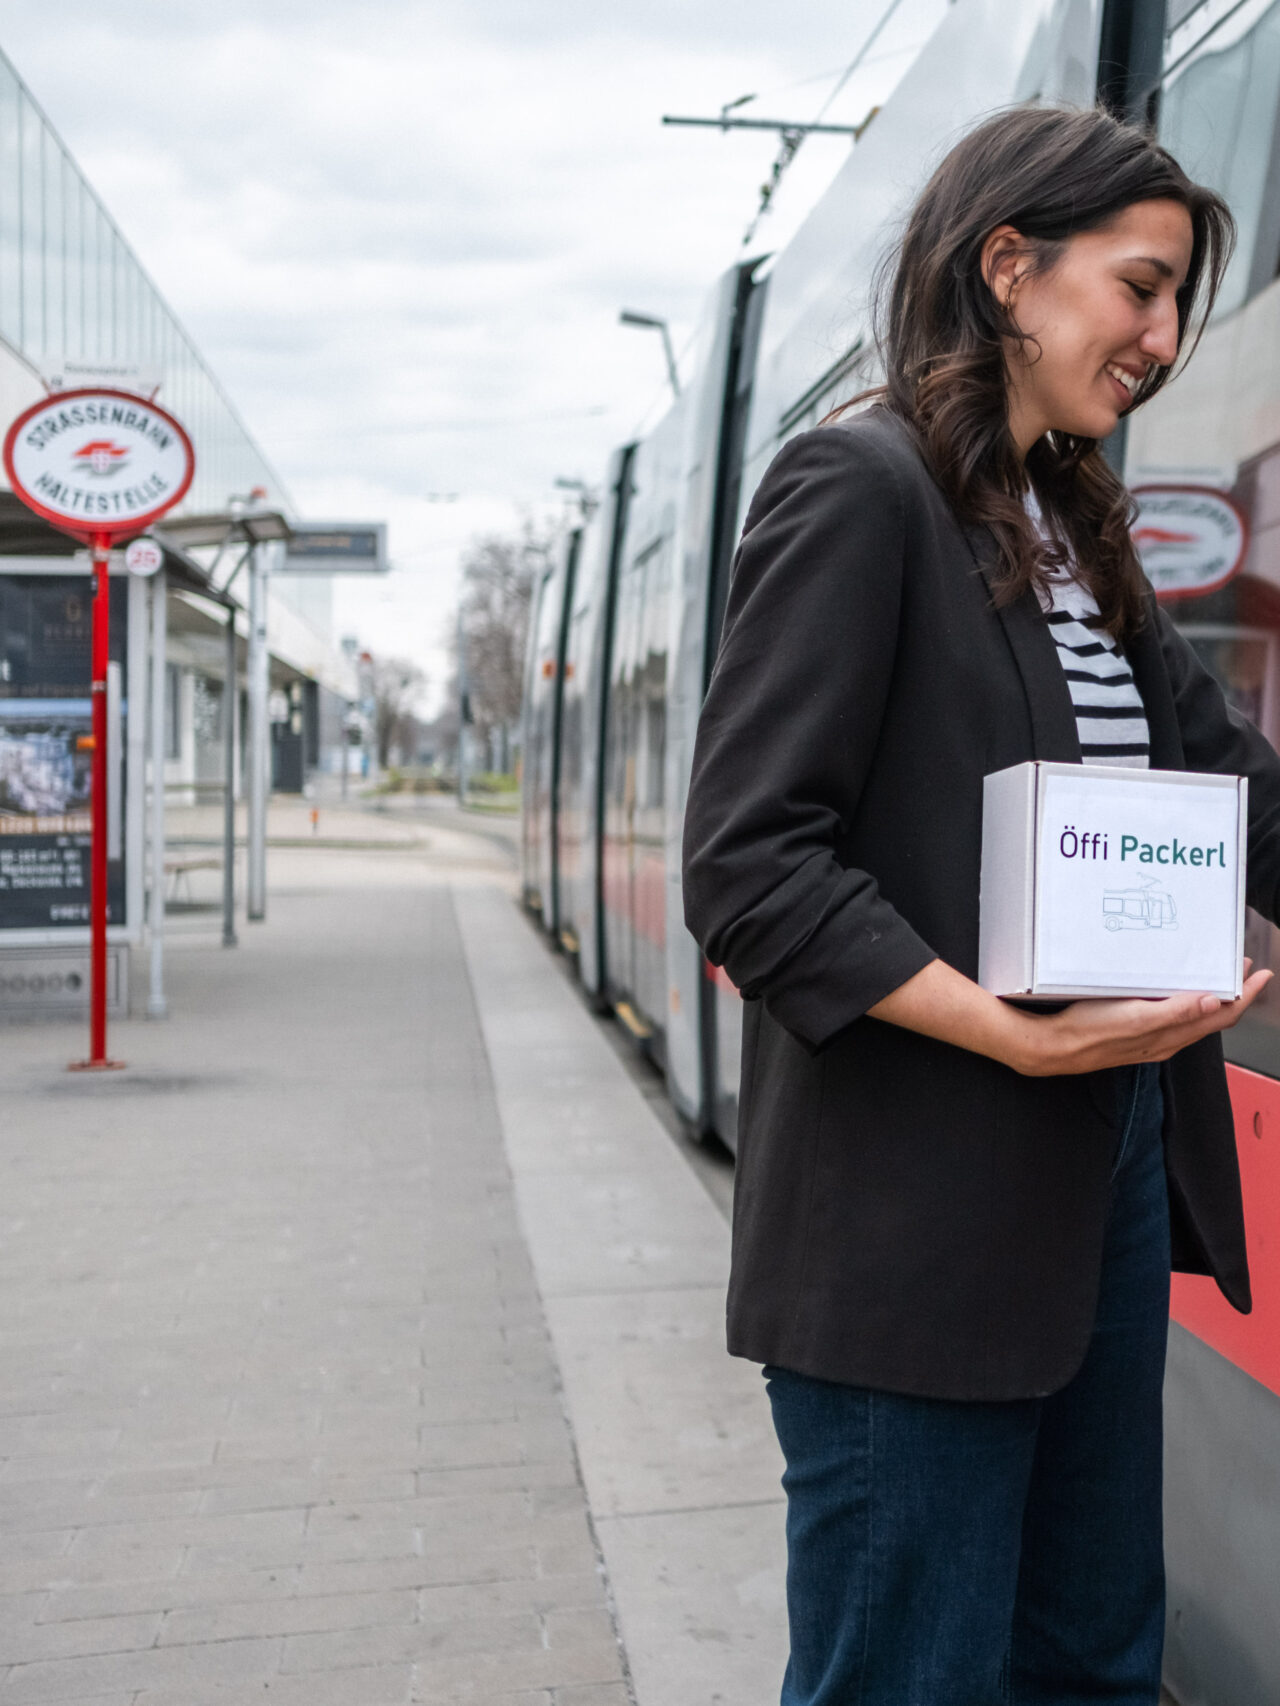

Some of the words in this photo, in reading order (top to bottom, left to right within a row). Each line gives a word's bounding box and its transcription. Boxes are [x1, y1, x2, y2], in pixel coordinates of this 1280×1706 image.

[27, 403, 173, 451] STRASSENBAHN
[34, 471, 169, 515] HALTESTELLE
[1059, 825, 1108, 860] Öffi
[1120, 835, 1226, 868] Packerl
